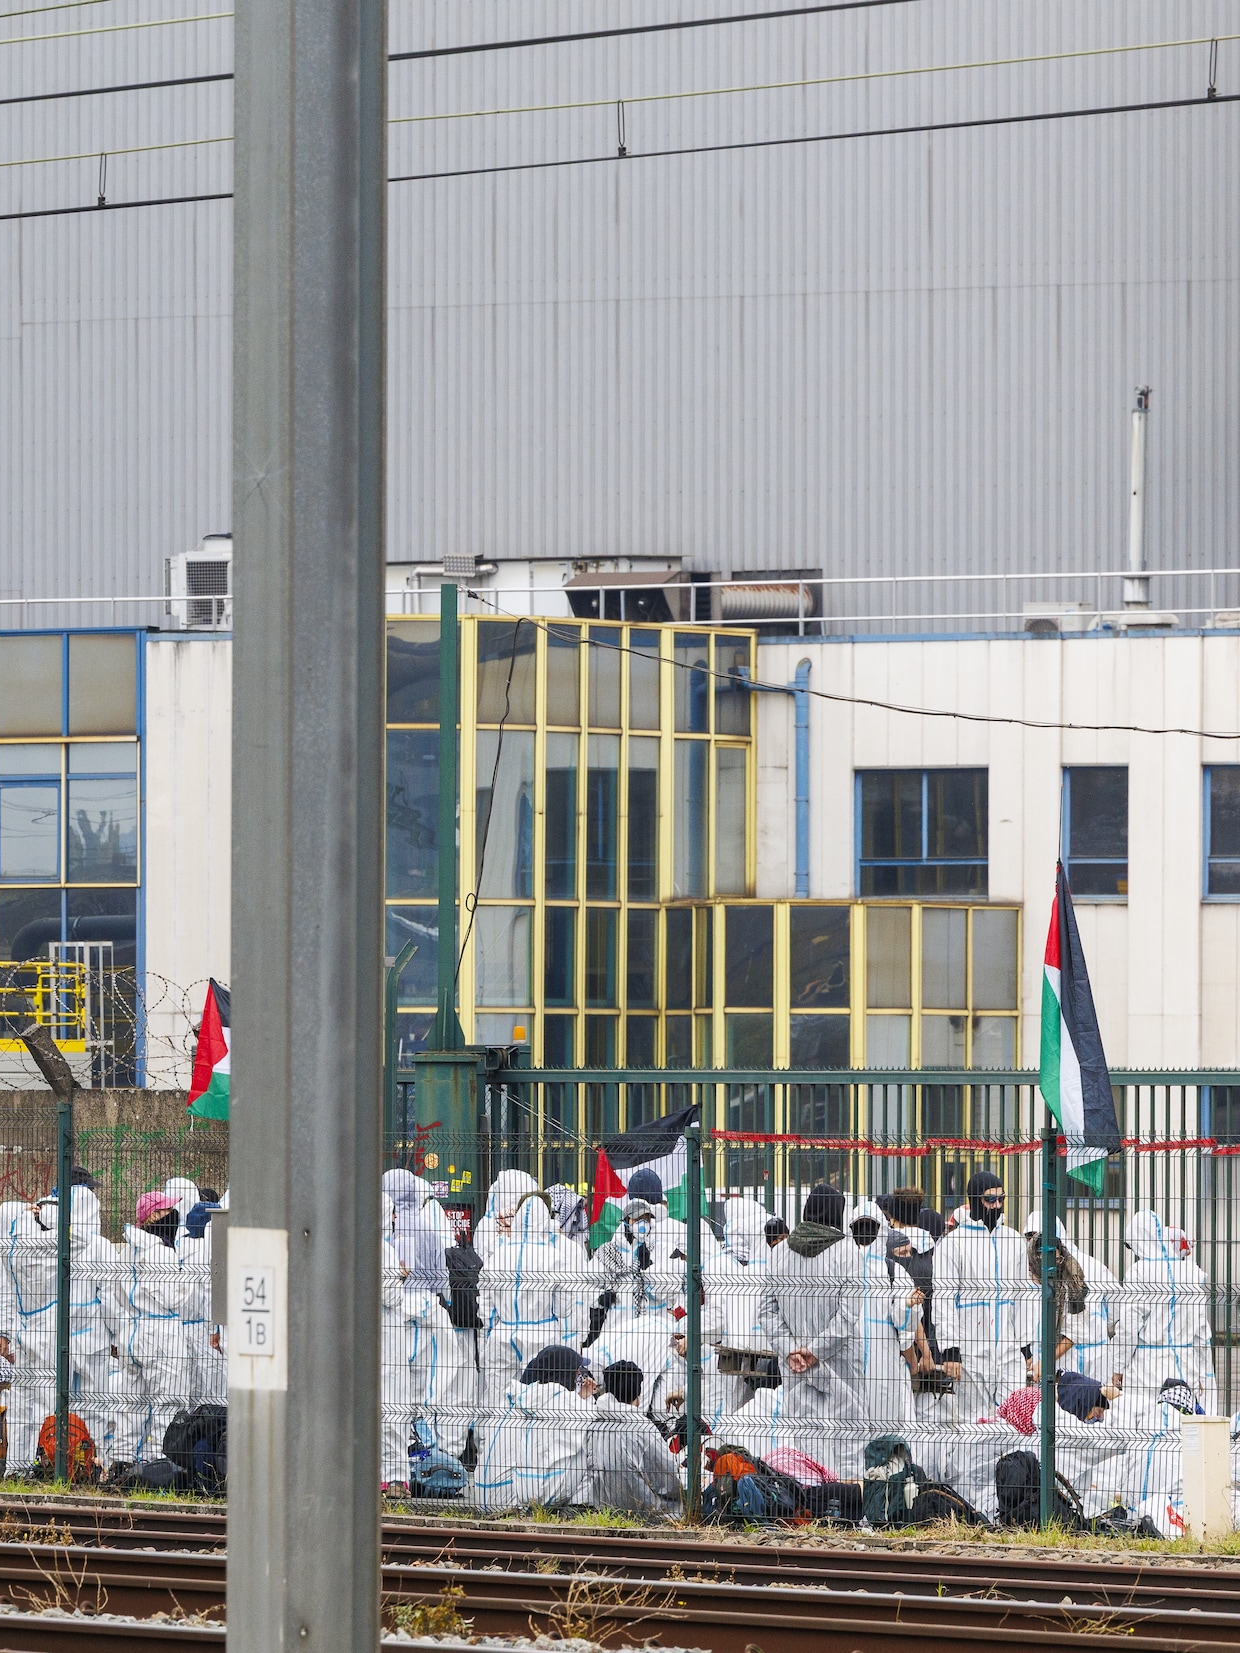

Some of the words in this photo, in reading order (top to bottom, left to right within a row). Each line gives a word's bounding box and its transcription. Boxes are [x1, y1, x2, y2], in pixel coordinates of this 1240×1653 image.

[447, 1211, 465, 1220] STOP
[243, 1276, 267, 1306] 54
[245, 1315, 267, 1346] 1B
